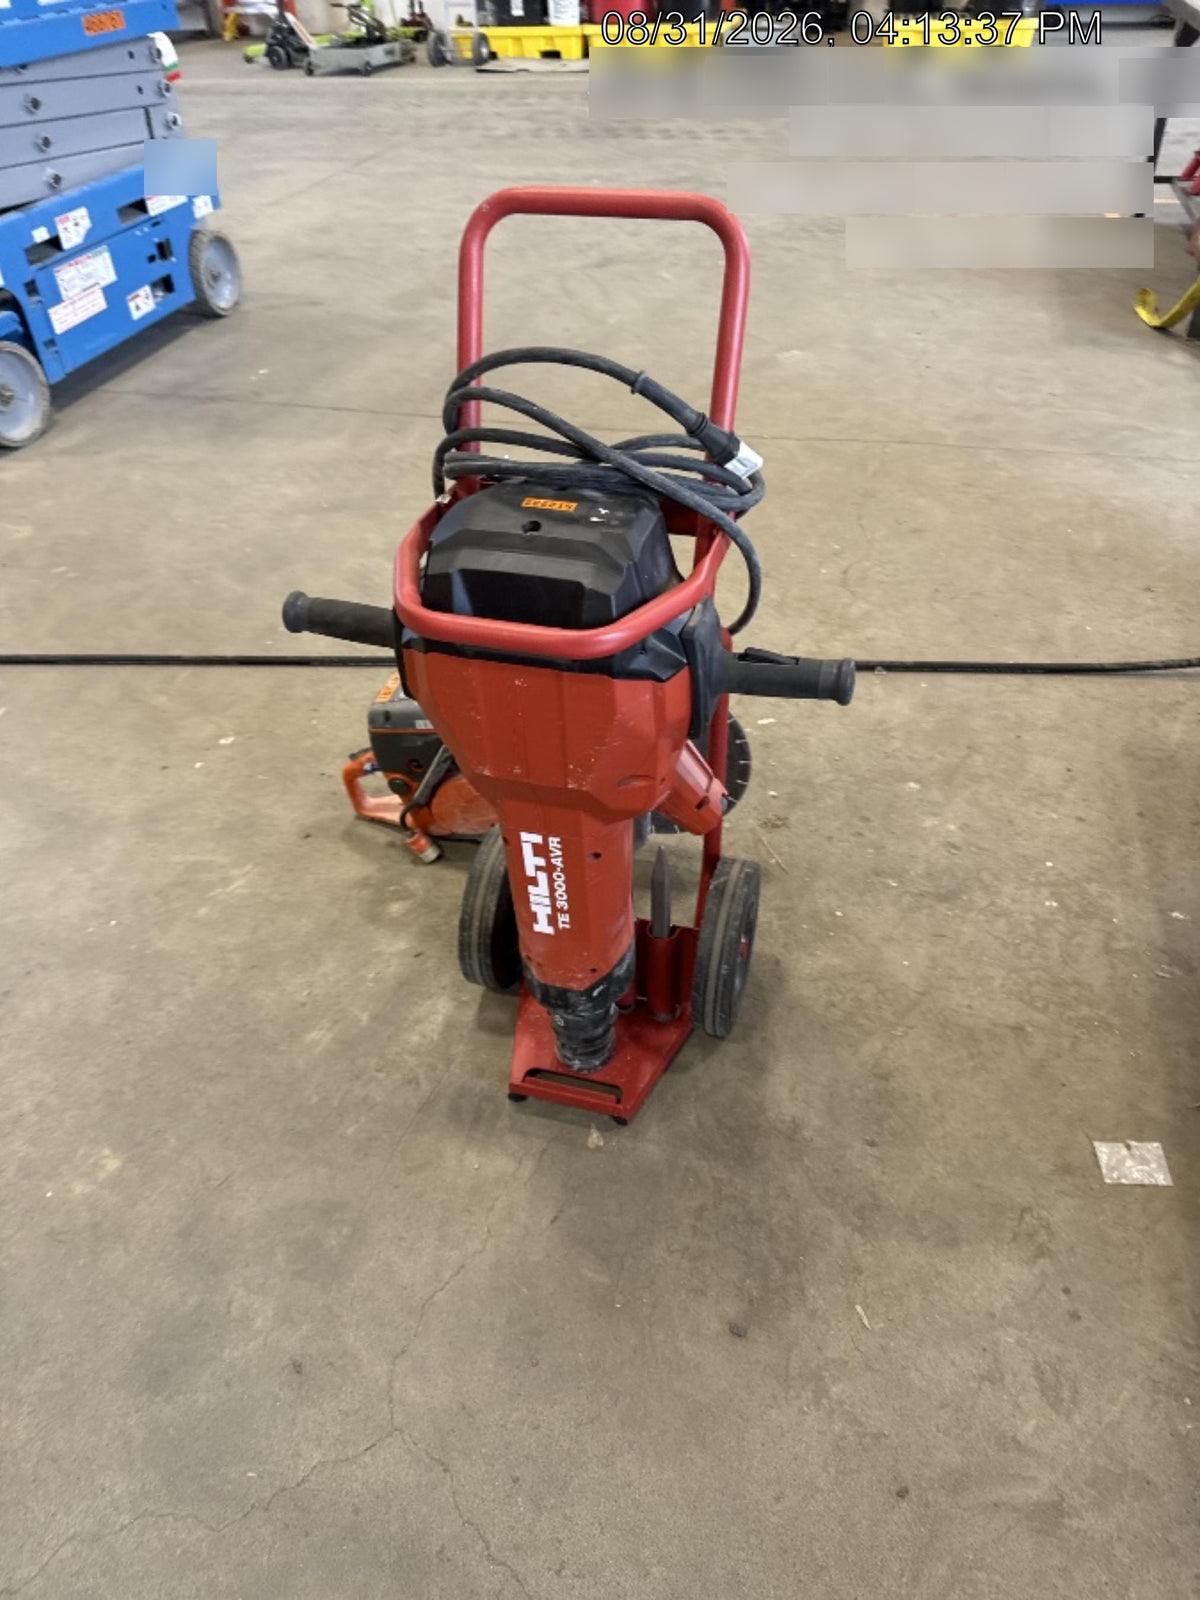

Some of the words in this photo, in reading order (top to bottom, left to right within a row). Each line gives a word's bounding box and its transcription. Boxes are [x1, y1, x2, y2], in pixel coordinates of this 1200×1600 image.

[519, 832, 555, 935] HILTI
[548, 836, 569, 910] 3000-AVR
[557, 912, 571, 929] TE
